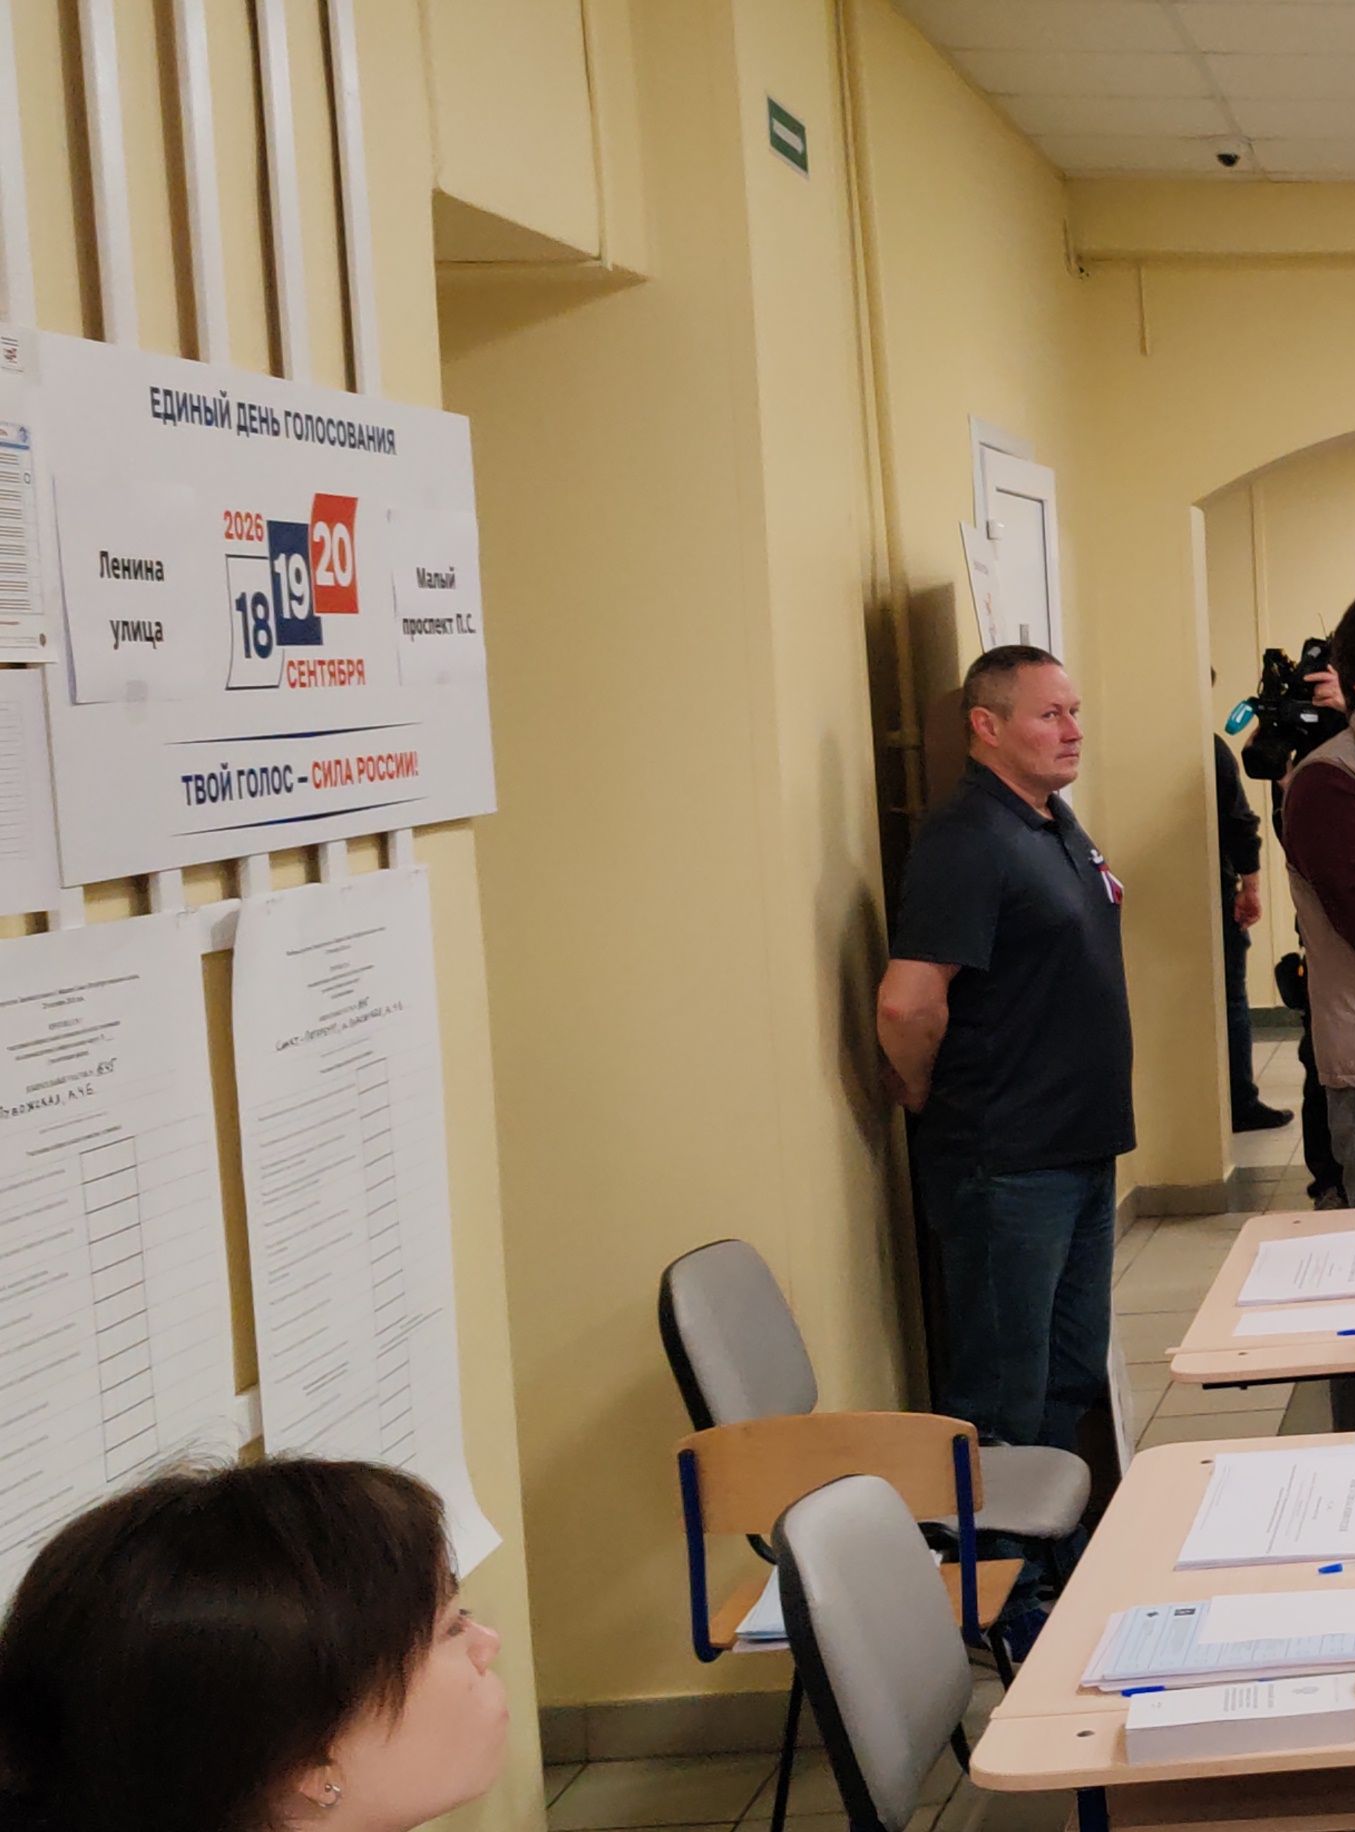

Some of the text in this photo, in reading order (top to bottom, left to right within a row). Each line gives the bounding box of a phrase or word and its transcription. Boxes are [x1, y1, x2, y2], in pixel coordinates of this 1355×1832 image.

[149, 386, 397, 455] ЕДИНЫЙ ДЕНЬ ГОЛОСОВАНИЯ
[223, 510, 264, 542] 2026
[99, 551, 165, 582] Ленина
[313, 521, 353, 587] 20
[273, 553, 310, 620] 19
[416, 565, 457, 589] Малый
[110, 618, 165, 649] улица
[235, 591, 274, 659] 18
[402, 617, 453, 642] проспект
[286, 658, 366, 690] СЕНТЯБРЯ
[181, 762, 233, 806] ТВОЙ
[236, 764, 294, 800] ГОЛОС
[311, 757, 354, 790] СИЛА
[356, 750, 419, 785] РОССИИ!
